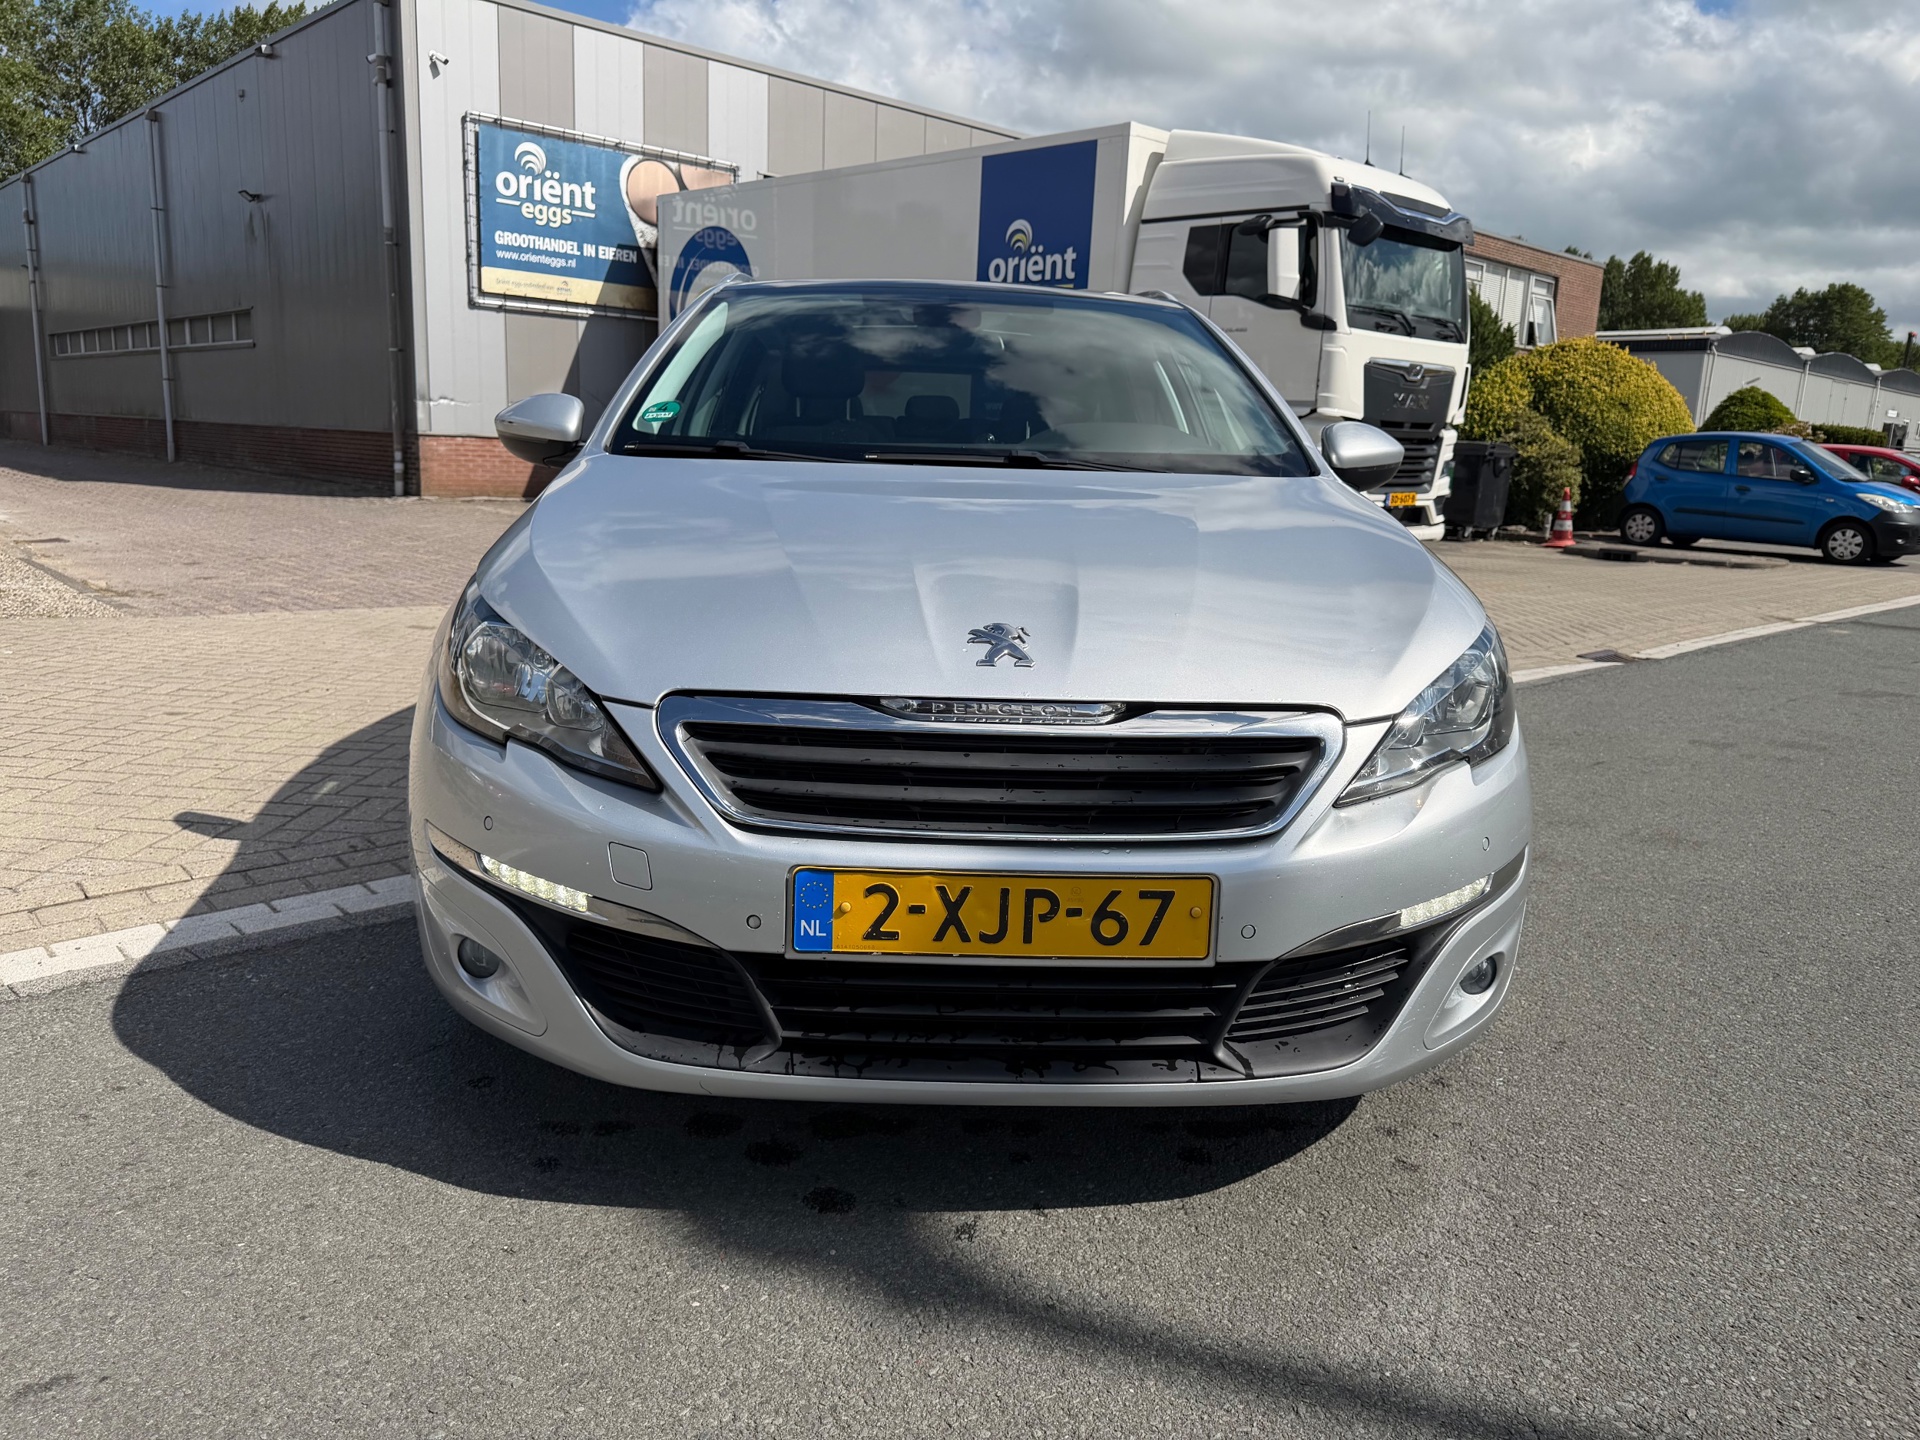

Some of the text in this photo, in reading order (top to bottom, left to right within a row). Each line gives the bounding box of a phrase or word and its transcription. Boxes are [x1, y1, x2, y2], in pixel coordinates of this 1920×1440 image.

[495, 170, 596, 211] oriënt
[521, 202, 573, 228] eggs
[494, 230, 581, 256] GROOTHANDEL
[583, 243, 596, 257] IN
[598, 245, 637, 264] EIEREN
[495, 250, 577, 269] www.orienteggs.nl
[988, 244, 1077, 283] oriënt
[658, 402, 668, 411] 4
[931, 702, 1078, 717] PEUGEOT
[862, 881, 1176, 947] 2-XJP-67
[800, 919, 827, 937] NL
